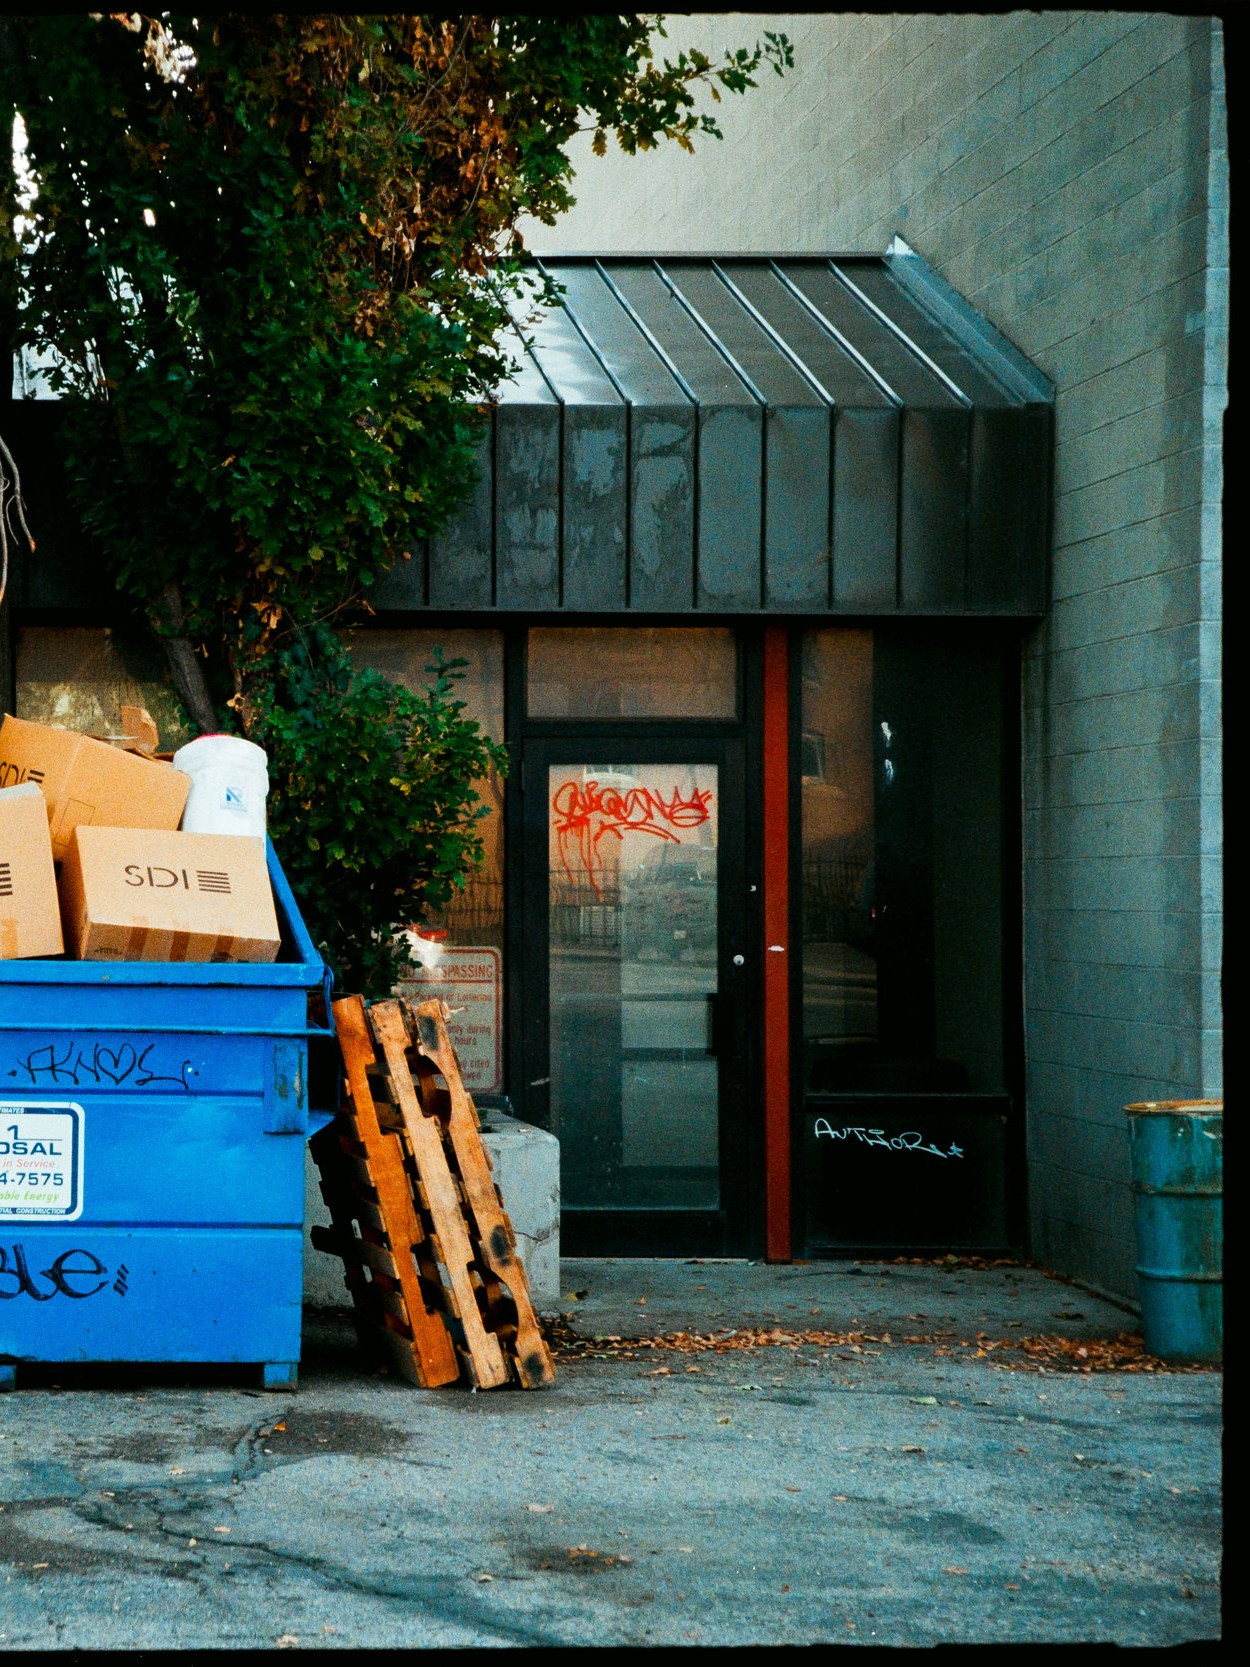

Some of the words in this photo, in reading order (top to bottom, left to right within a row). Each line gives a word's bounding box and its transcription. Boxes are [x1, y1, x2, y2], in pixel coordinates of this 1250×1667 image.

[125, 864, 189, 890] SDI
[3, 1159, 13, 1167] in
[16, 1158, 55, 1168] Service
[24, 1190, 60, 1204] Energy
[15, 1207, 66, 1215] CONSTRUCTION
